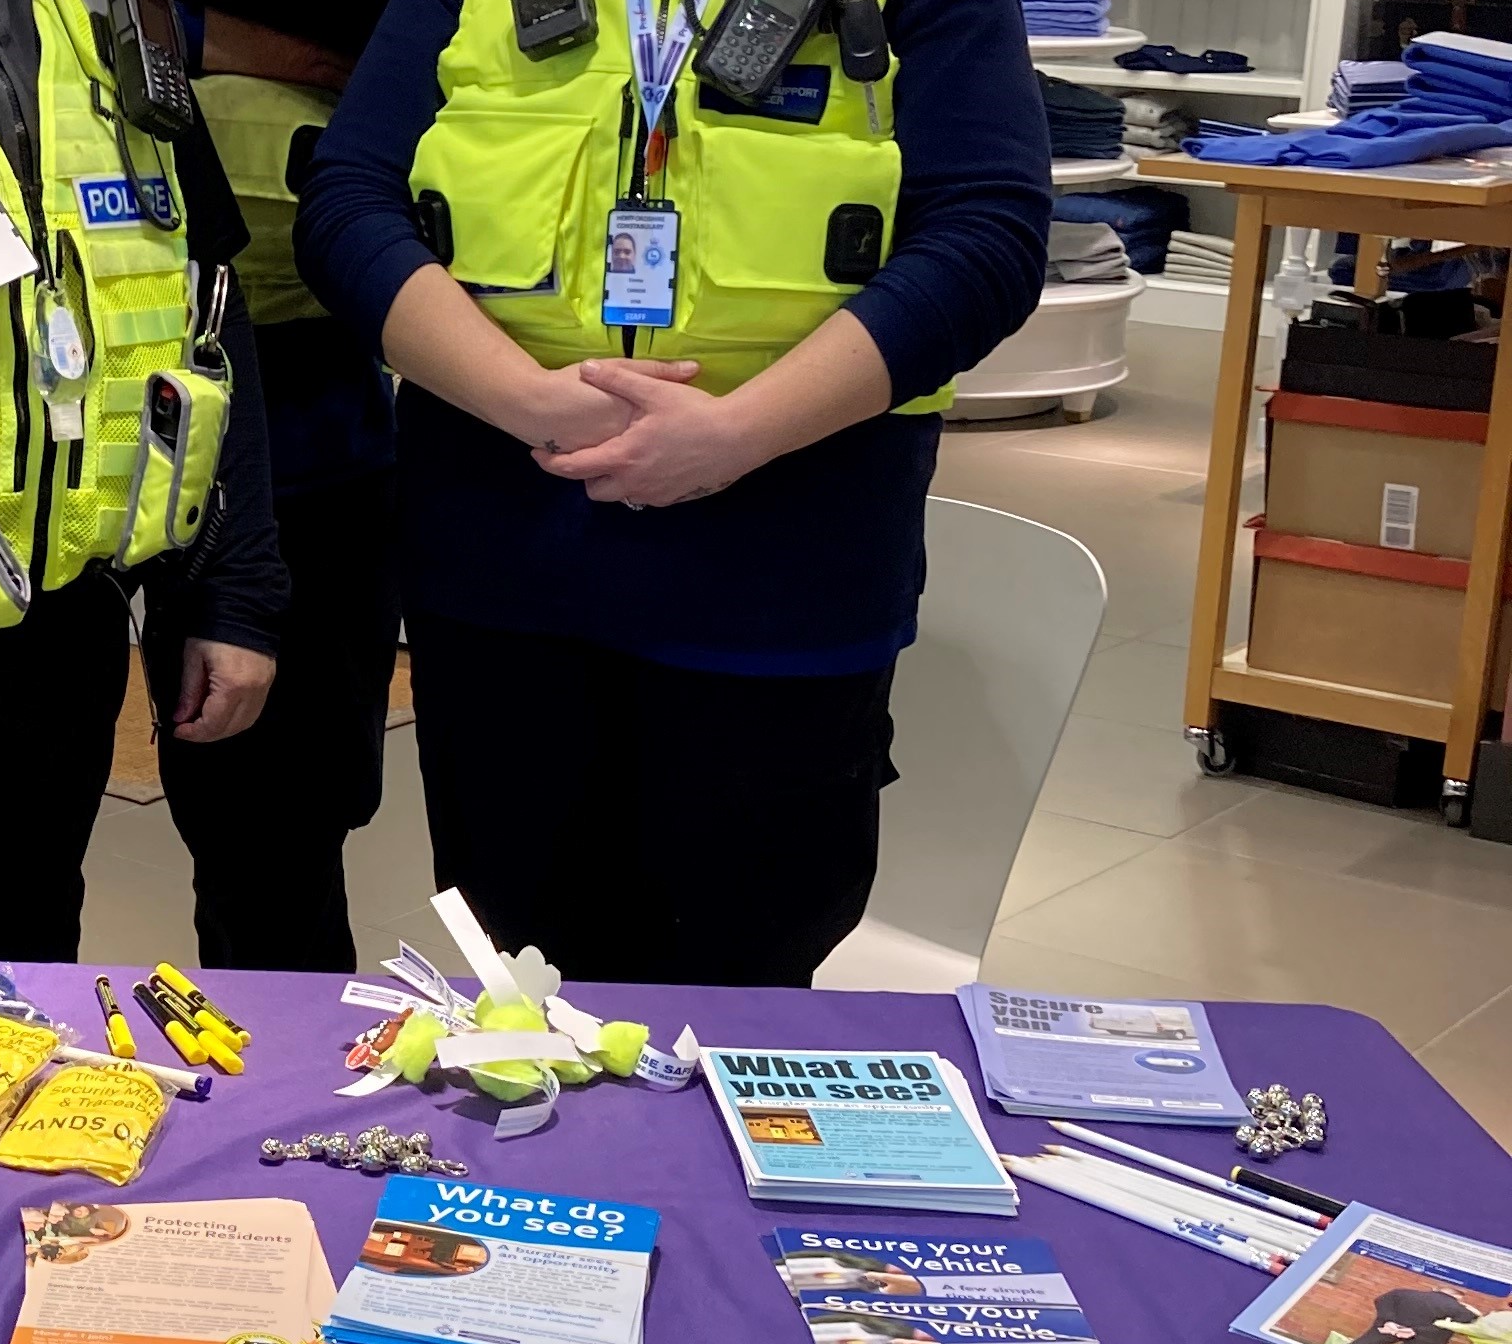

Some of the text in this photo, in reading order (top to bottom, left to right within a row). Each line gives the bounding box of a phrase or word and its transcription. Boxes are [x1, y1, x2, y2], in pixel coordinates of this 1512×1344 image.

[988, 991, 1103, 1014] Secure
[990, 1005, 1064, 1022] your
[992, 1015, 1051, 1032] van
[640, 1053, 659, 1069] BE
[719, 1055, 933, 1081] What do
[728, 1080, 942, 1102] you see?
[10, 1115, 107, 1132] HANDS
[437, 1183, 626, 1224] What do
[144, 1216, 238, 1232] Protecting
[428, 1204, 625, 1242] you see?
[143, 1225, 292, 1243] Senior Residents
[516, 1246, 574, 1260] burglar
[800, 1233, 1008, 1258] Secure your
[522, 1255, 620, 1275] opportunity
[898, 1256, 1023, 1275] Vehicle
[959, 1284, 988, 1294] few
[993, 1286, 1045, 1296] simple
[824, 1296, 1040, 1322] Secure your
[927, 1321, 1057, 1342] Vehicle
